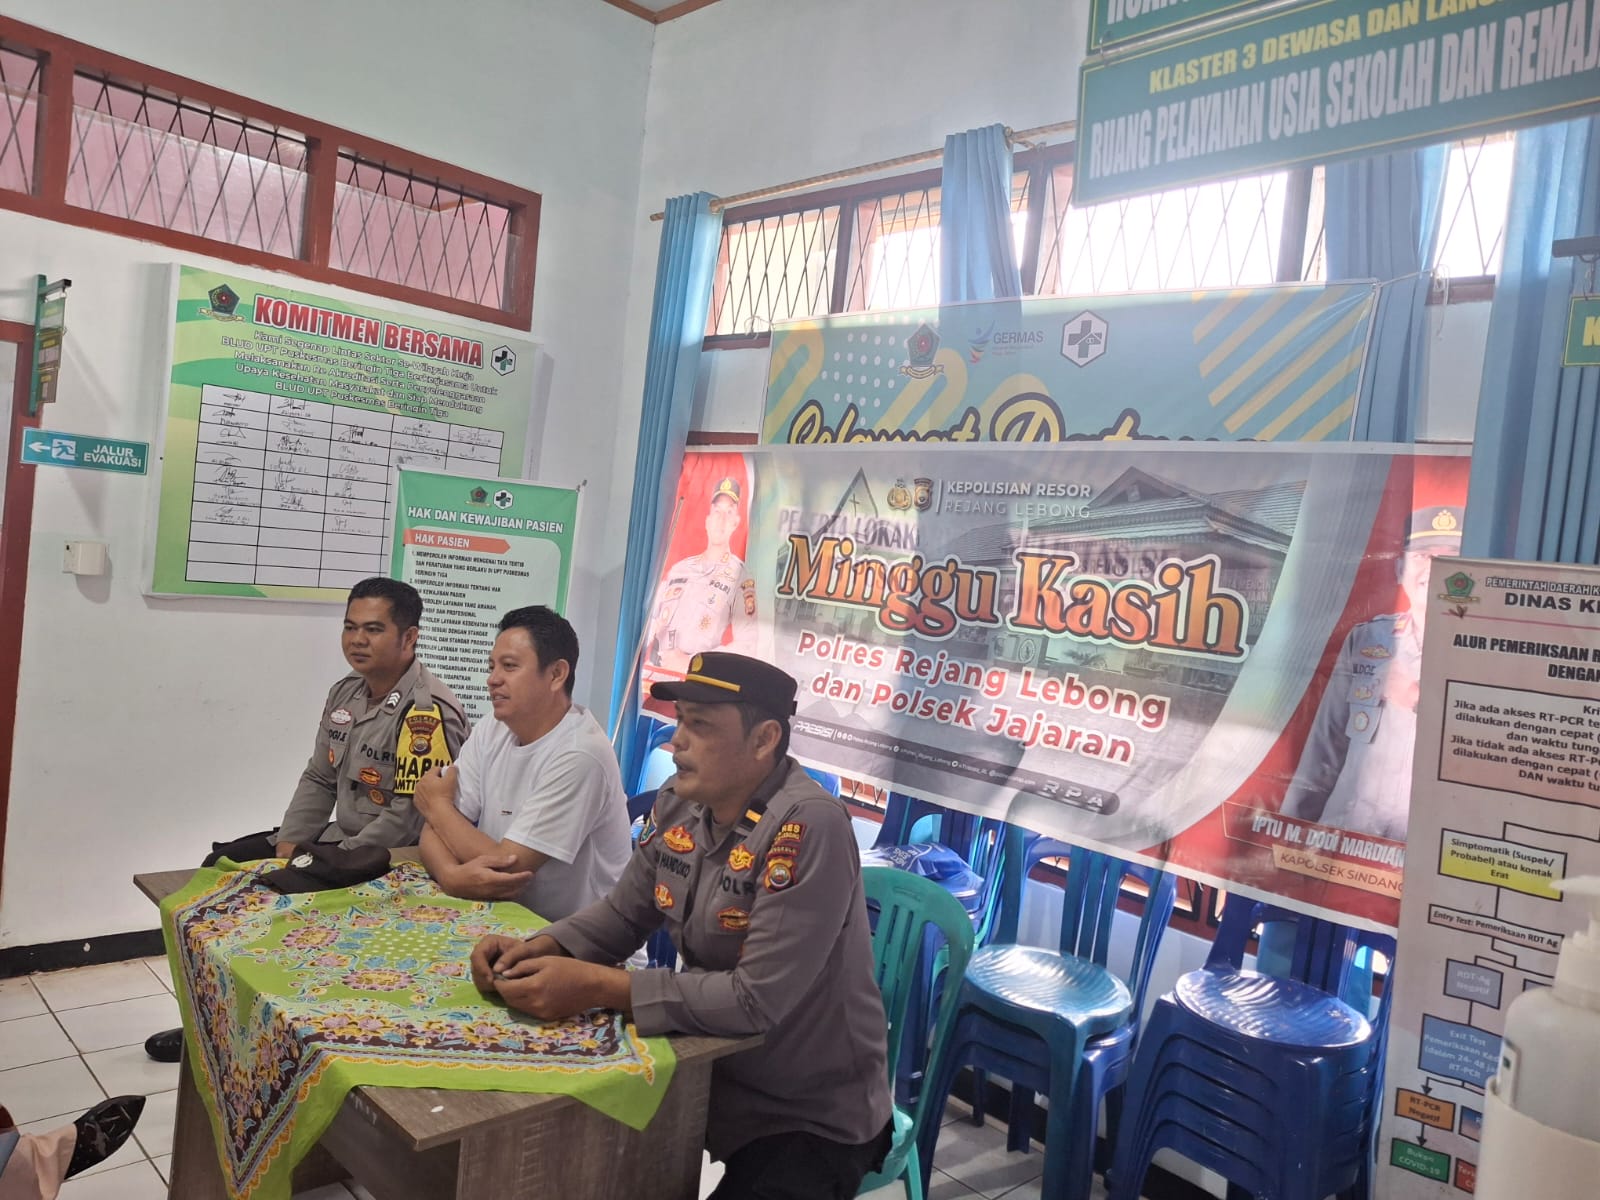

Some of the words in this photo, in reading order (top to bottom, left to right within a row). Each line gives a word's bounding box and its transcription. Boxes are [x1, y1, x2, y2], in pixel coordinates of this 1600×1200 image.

[1150, 48, 1238, 94] KLASTER
[1242, 43, 1257, 70] 3
[1262, 14, 1361, 64] DEWASA
[1367, 0, 1420, 37] DAN
[1089, 110, 1152, 179] RUANG
[1155, 82, 1265, 165] PELAYANAN
[1268, 67, 1321, 140] USIA
[1326, 38, 1435, 128] SEKOLAH
[1439, 22, 1497, 102] DAN
[1501, 0, 1600, 90] REMAJ
[255, 296, 380, 346] KOMITMEN
[383, 322, 483, 367] BERSAMA
[993, 331, 1044, 345] GERMAS
[222, 336, 253, 350] BLUD
[256, 343, 279, 354] UPT
[280, 348, 339, 366] Puskesmas
[341, 358, 382, 374] Beringin
[385, 367, 405, 379] Tiga
[255, 331, 282, 344] Kami
[284, 337, 330, 354] Segenap
[332, 346, 362, 359] Lintas
[365, 352, 396, 366] Sektor
[235, 351, 311, 371] Melaksanakan
[329, 368, 378, 385] Akreditasi
[381, 377, 405, 390] Serta
[235, 363, 269, 377] Upaya
[272, 369, 326, 387] Kesehatan
[329, 380, 385, 397] Masyarakat
[388, 388, 406, 400] dan
[408, 393, 427, 405] Siap
[275, 381, 305, 393] BLUD
[307, 387, 329, 397] UPT
[331, 391, 386, 407] Puskesmas
[387, 400, 427, 414] Beringin
[430, 407, 449, 418] Tiga
[83, 452, 142, 467] EVAKUASI
[93, 444, 134, 458] JALUR
[947, 481, 1032, 496] KEPOLISIAN
[1036, 483, 1091, 497] RESOR
[408, 507, 431, 519] HAK
[434, 510, 457, 522] DAN
[460, 513, 523, 530] KEWAJIBAN
[526, 519, 564, 534] PASIEN
[945, 500, 1007, 514] REJANG
[1016, 503, 1090, 518] LEBONG
[415, 533, 435, 545] HAK
[437, 535, 470, 548] PASIEN
[777, 534, 999, 636] Minggu
[1006, 550, 1245, 658] Kasih
[1485, 577, 1548, 591] PEMERINTAH
[1550, 581, 1591, 595] DAERAH
[1504, 593, 1572, 610] DINAS
[1453, 634, 1488, 650] ALUR
[1490, 638, 1589, 662] PEMERIKSAAN
[798, 631, 884, 668] Polres
[894, 649, 1007, 697] Rejang
[1020, 670, 1167, 729] Lebong
[812, 671, 862, 701] dan
[871, 683, 977, 727] Polsek
[986, 707, 1132, 763] Jajaran
[1453, 700, 1477, 711] Jika
[1479, 704, 1500, 714] ada
[1503, 707, 1536, 719] akses
[1539, 712, 1585, 726] RT-PCR
[1455, 712, 1511, 728] dilakukan
[1513, 720, 1557, 736] dengan
[1560, 729, 1594, 741] cepat
[1450, 735, 1473, 746] Jika
[1476, 739, 1505, 751] tidak
[1508, 744, 1529, 755] ada
[1532, 749, 1566, 761] akses
[1506, 731, 1528, 742] dan
[1532, 736, 1568, 749] waktu
[1453, 747, 1508, 763] dilakukan
[1511, 757, 1554, 771] dengan
[1557, 765, 1591, 778] cepat
[1518, 769, 1544, 781] DAN
[1547, 776, 1585, 788] waktu
[1252, 816, 1283, 837] IPTU
[1284, 823, 1301, 844] M.
[1281, 853, 1344, 877] KAPOLSEK
[1450, 850, 1495, 866] Probabel)
[1498, 860, 1518, 871] atau
[1520, 863, 1553, 878] kontak
[1451, 838, 1510, 856] Simptomatik
[1512, 849, 1555, 868] (Suspek/
[1490, 868, 1509, 880] Erat
[1433, 911, 1454, 923] Entry
[1456, 915, 1474, 926] Test:
[1475, 920, 1526, 940] Pemeriksaan
[1528, 933, 1545, 945] RDT
[1547, 938, 1558, 949] Ag
[1424, 1034, 1481, 1056] Pemeriksaan
[1450, 1030, 1466, 1041] Exit
[1469, 1034, 1486, 1047] Test
